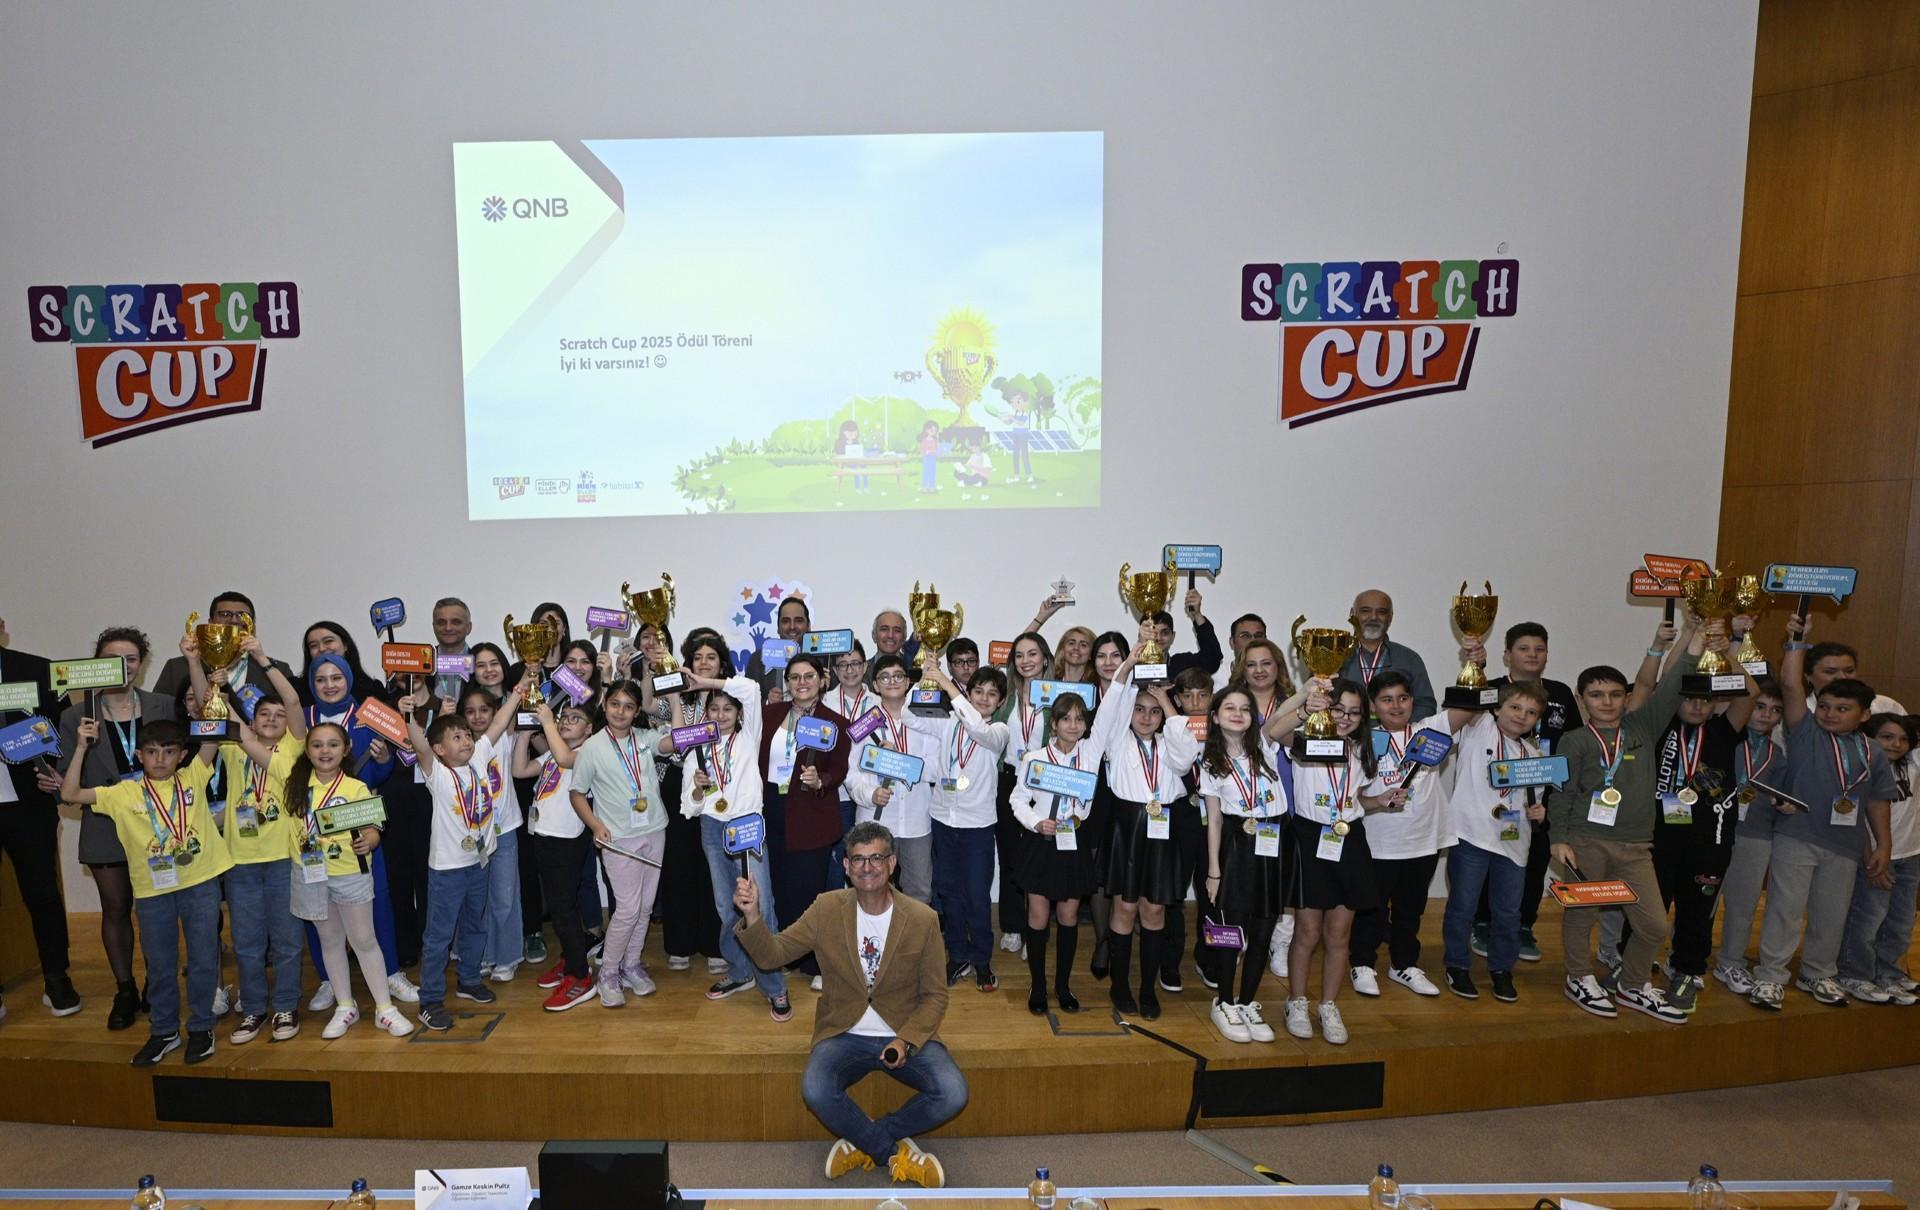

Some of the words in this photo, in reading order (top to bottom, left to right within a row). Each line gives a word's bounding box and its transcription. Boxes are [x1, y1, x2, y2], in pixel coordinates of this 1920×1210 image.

[512, 198, 569, 220] QNB
[39, 289, 290, 336] SCRATCH
[1250, 268, 1509, 316] SCRATCH
[559, 336, 608, 350] Scratch
[611, 336, 637, 351] Cup
[640, 336, 672, 348] 2025
[677, 332, 708, 348] Ödül
[712, 333, 753, 348] Töreni
[579, 356, 592, 369] ki
[594, 356, 649, 370] varsınız!
[1300, 325, 1445, 400] CUP
[95, 346, 234, 419] CUP
